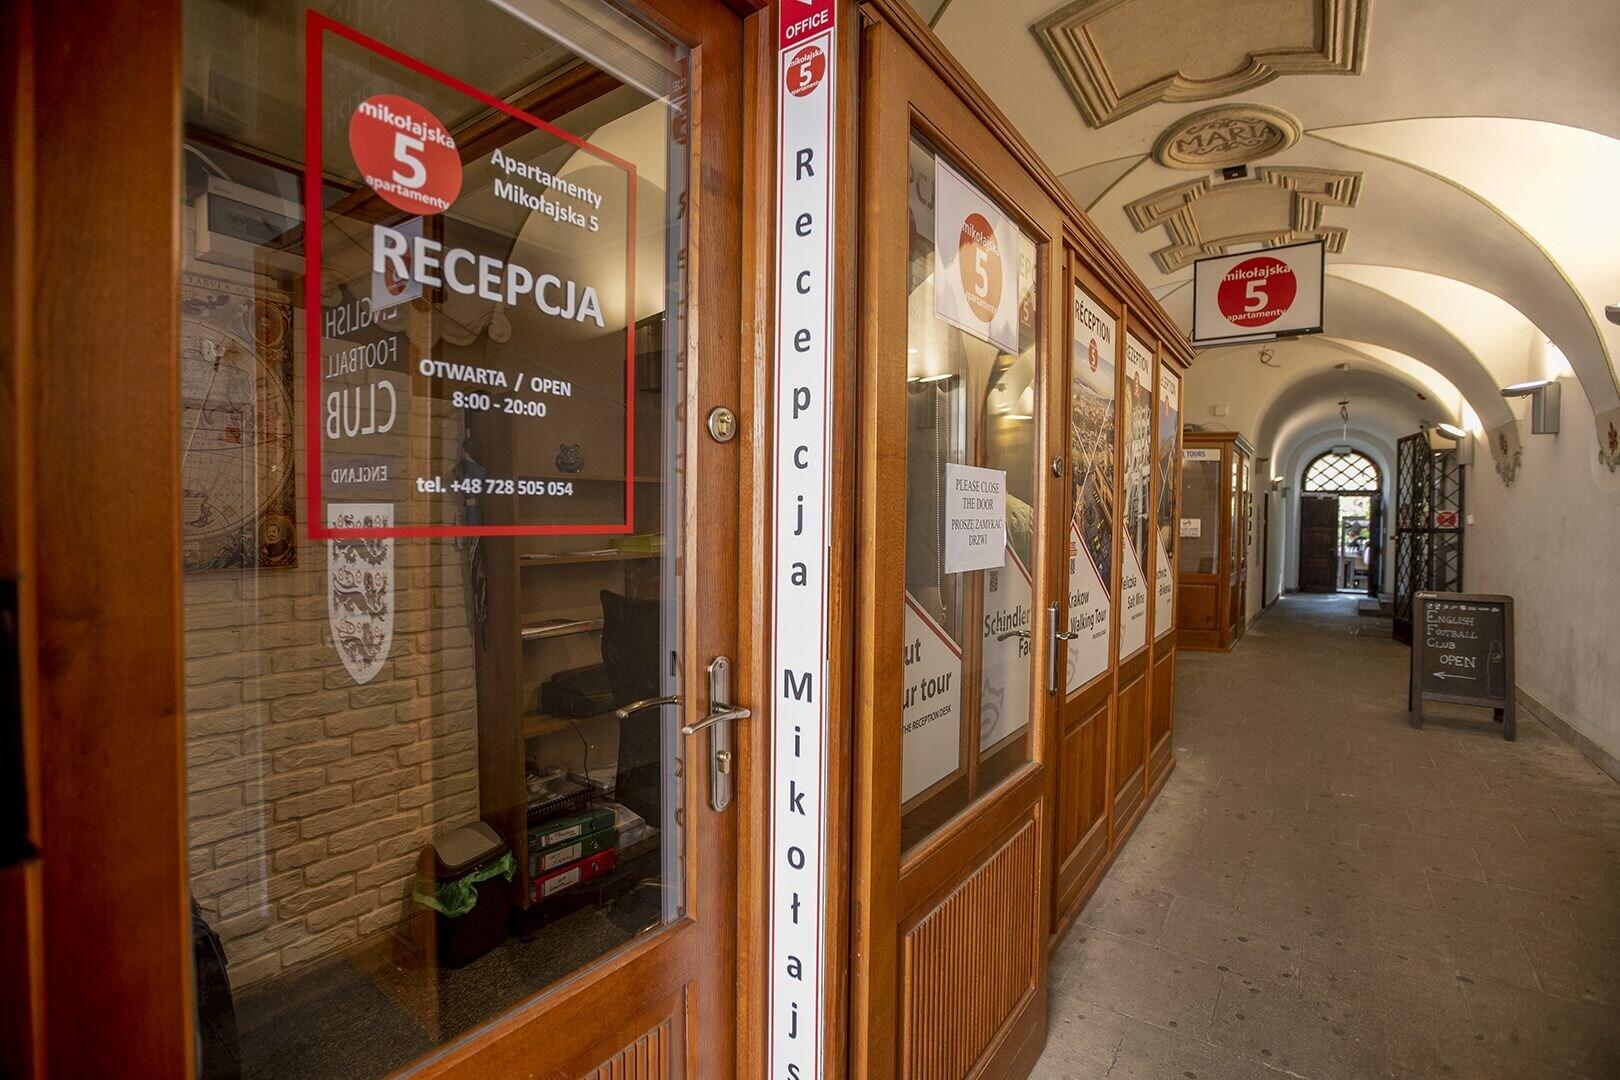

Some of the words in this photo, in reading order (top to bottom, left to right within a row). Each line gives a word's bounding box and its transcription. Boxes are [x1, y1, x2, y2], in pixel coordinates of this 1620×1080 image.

[785, 9, 828, 39] OFFICE
[799, 62, 812, 87] 5
[359, 102, 456, 150] mikołajska
[392, 132, 427, 189] 5
[490, 148, 602, 209] Apartamenty
[365, 175, 450, 210] apartamenty
[494, 178, 585, 223] Mikołajska
[588, 215, 600, 233] 5
[372, 224, 605, 328] RECEPCJA
[974, 248, 988, 298] 5
[1223, 263, 1292, 283] mikołajska
[1244, 279, 1269, 312] 5
[1075, 299, 1110, 344] RÉCEPTION
[1226, 307, 1286, 323] apartamenty
[419, 359, 508, 388] OTWARTA
[514, 372, 524, 392] /
[530, 377, 572, 397] OPEN
[452, 391, 491, 411] 8:00
[503, 397, 547, 417] 20:00
[416, 476, 447, 493] tel.
[450, 478, 483, 494] +48
[485, 479, 515, 495] 728
[517, 480, 545, 496] 505
[547, 482, 574, 497] 054
[955, 478, 980, 493] PLEASE
[980, 481, 1000, 494] CLOSE
[963, 496, 975, 510] THE
[976, 498, 994, 511] DOOR
[968, 534, 988, 546] DRZWI
[1070, 612, 1095, 634] Walking
[1095, 608, 1107, 625] Tour
[1426, 610, 1475, 627] ENGLISH
[1427, 624, 1478, 639] FOOTBALL
[1426, 638, 1457, 650] CLUB
[1440, 654, 1477, 668] OPEN
[920, 671, 952, 702] tour
[911, 710, 939, 731] RECEPTION
[939, 704, 952, 718] DESK
